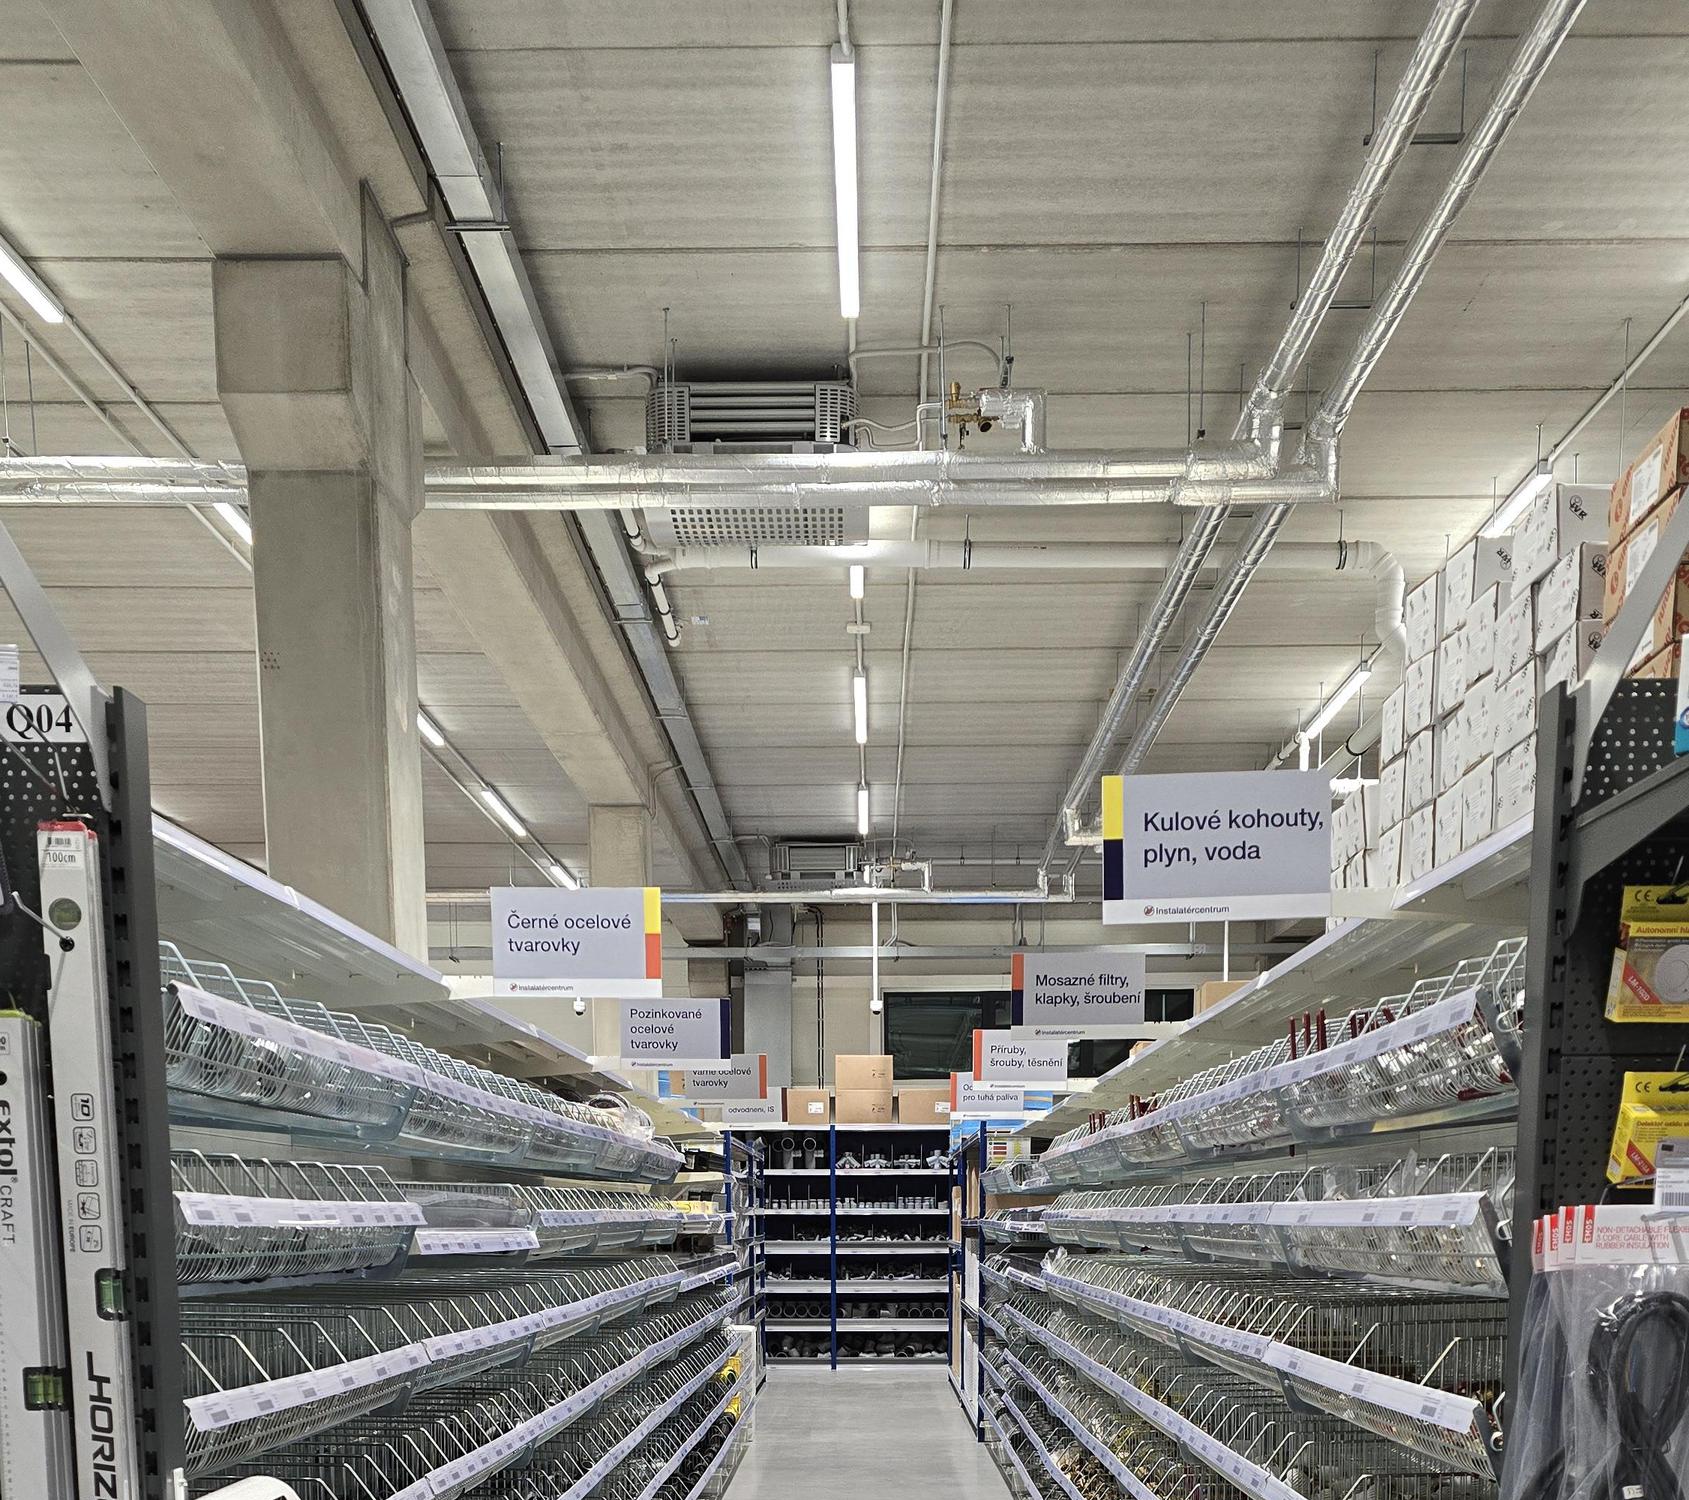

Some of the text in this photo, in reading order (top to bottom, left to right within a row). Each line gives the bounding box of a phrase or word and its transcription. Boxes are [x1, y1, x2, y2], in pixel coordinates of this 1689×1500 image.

[6, 703, 73, 740] Q04
[1143, 807, 1324, 832] Kulové kohouty,
[46, 851, 76, 863] 100cm
[1143, 840, 1261, 868] plyn, voda
[1155, 905, 1230, 916] Instalatércentrum
[507, 908, 631, 930] Černé ocelové
[508, 937, 580, 956] tvarovky
[1035, 973, 1129, 988] Mosazné filtry,
[1035, 991, 1141, 1007] klapky, šroubení
[630, 1007, 702, 1020] Pozinkované
[630, 1022, 674, 1034] ocelové
[630, 1038, 678, 1051] tvarovky
[990, 1044, 1027, 1056] Příruby,
[990, 1056, 1063, 1068] šrouby, těsnění
[692, 1078, 728, 1089] tvarovky
[1635, 1081, 1652, 1093] CE
[977, 1093, 994, 1102] tuhá
[996, 1093, 1018, 1102] paliva
[0, 1185, 16, 1244] CRAFT
[1597, 1226, 1662, 1234] NON-DETACHABLE
